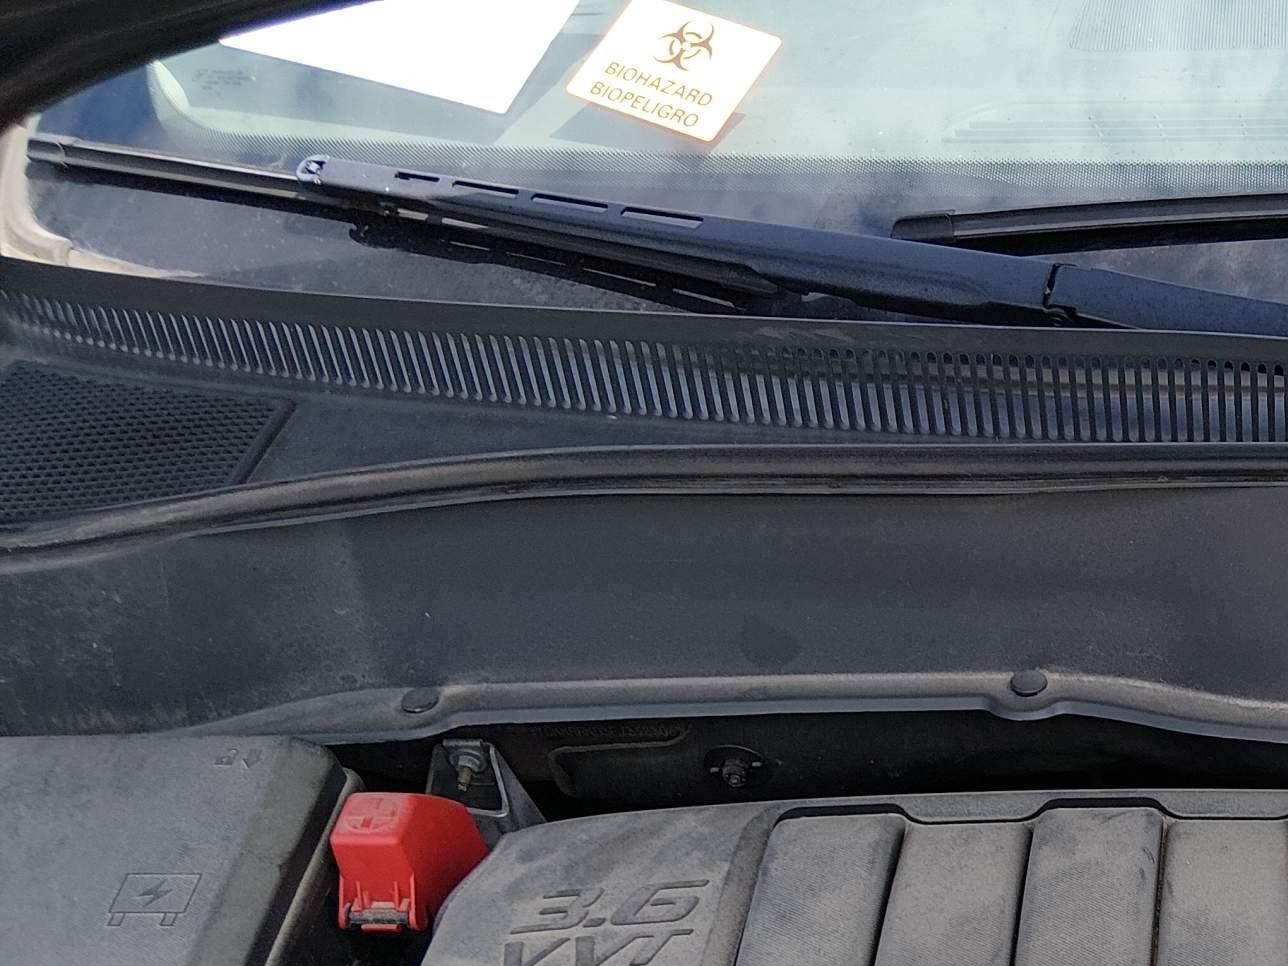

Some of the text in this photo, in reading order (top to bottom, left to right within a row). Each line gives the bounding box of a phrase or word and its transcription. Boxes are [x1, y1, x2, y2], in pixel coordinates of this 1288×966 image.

[590, 81, 699, 128] BIOPELIGRO
[604, 61, 713, 106] BIOHAZARD
[509, 879, 710, 935] 3.6
